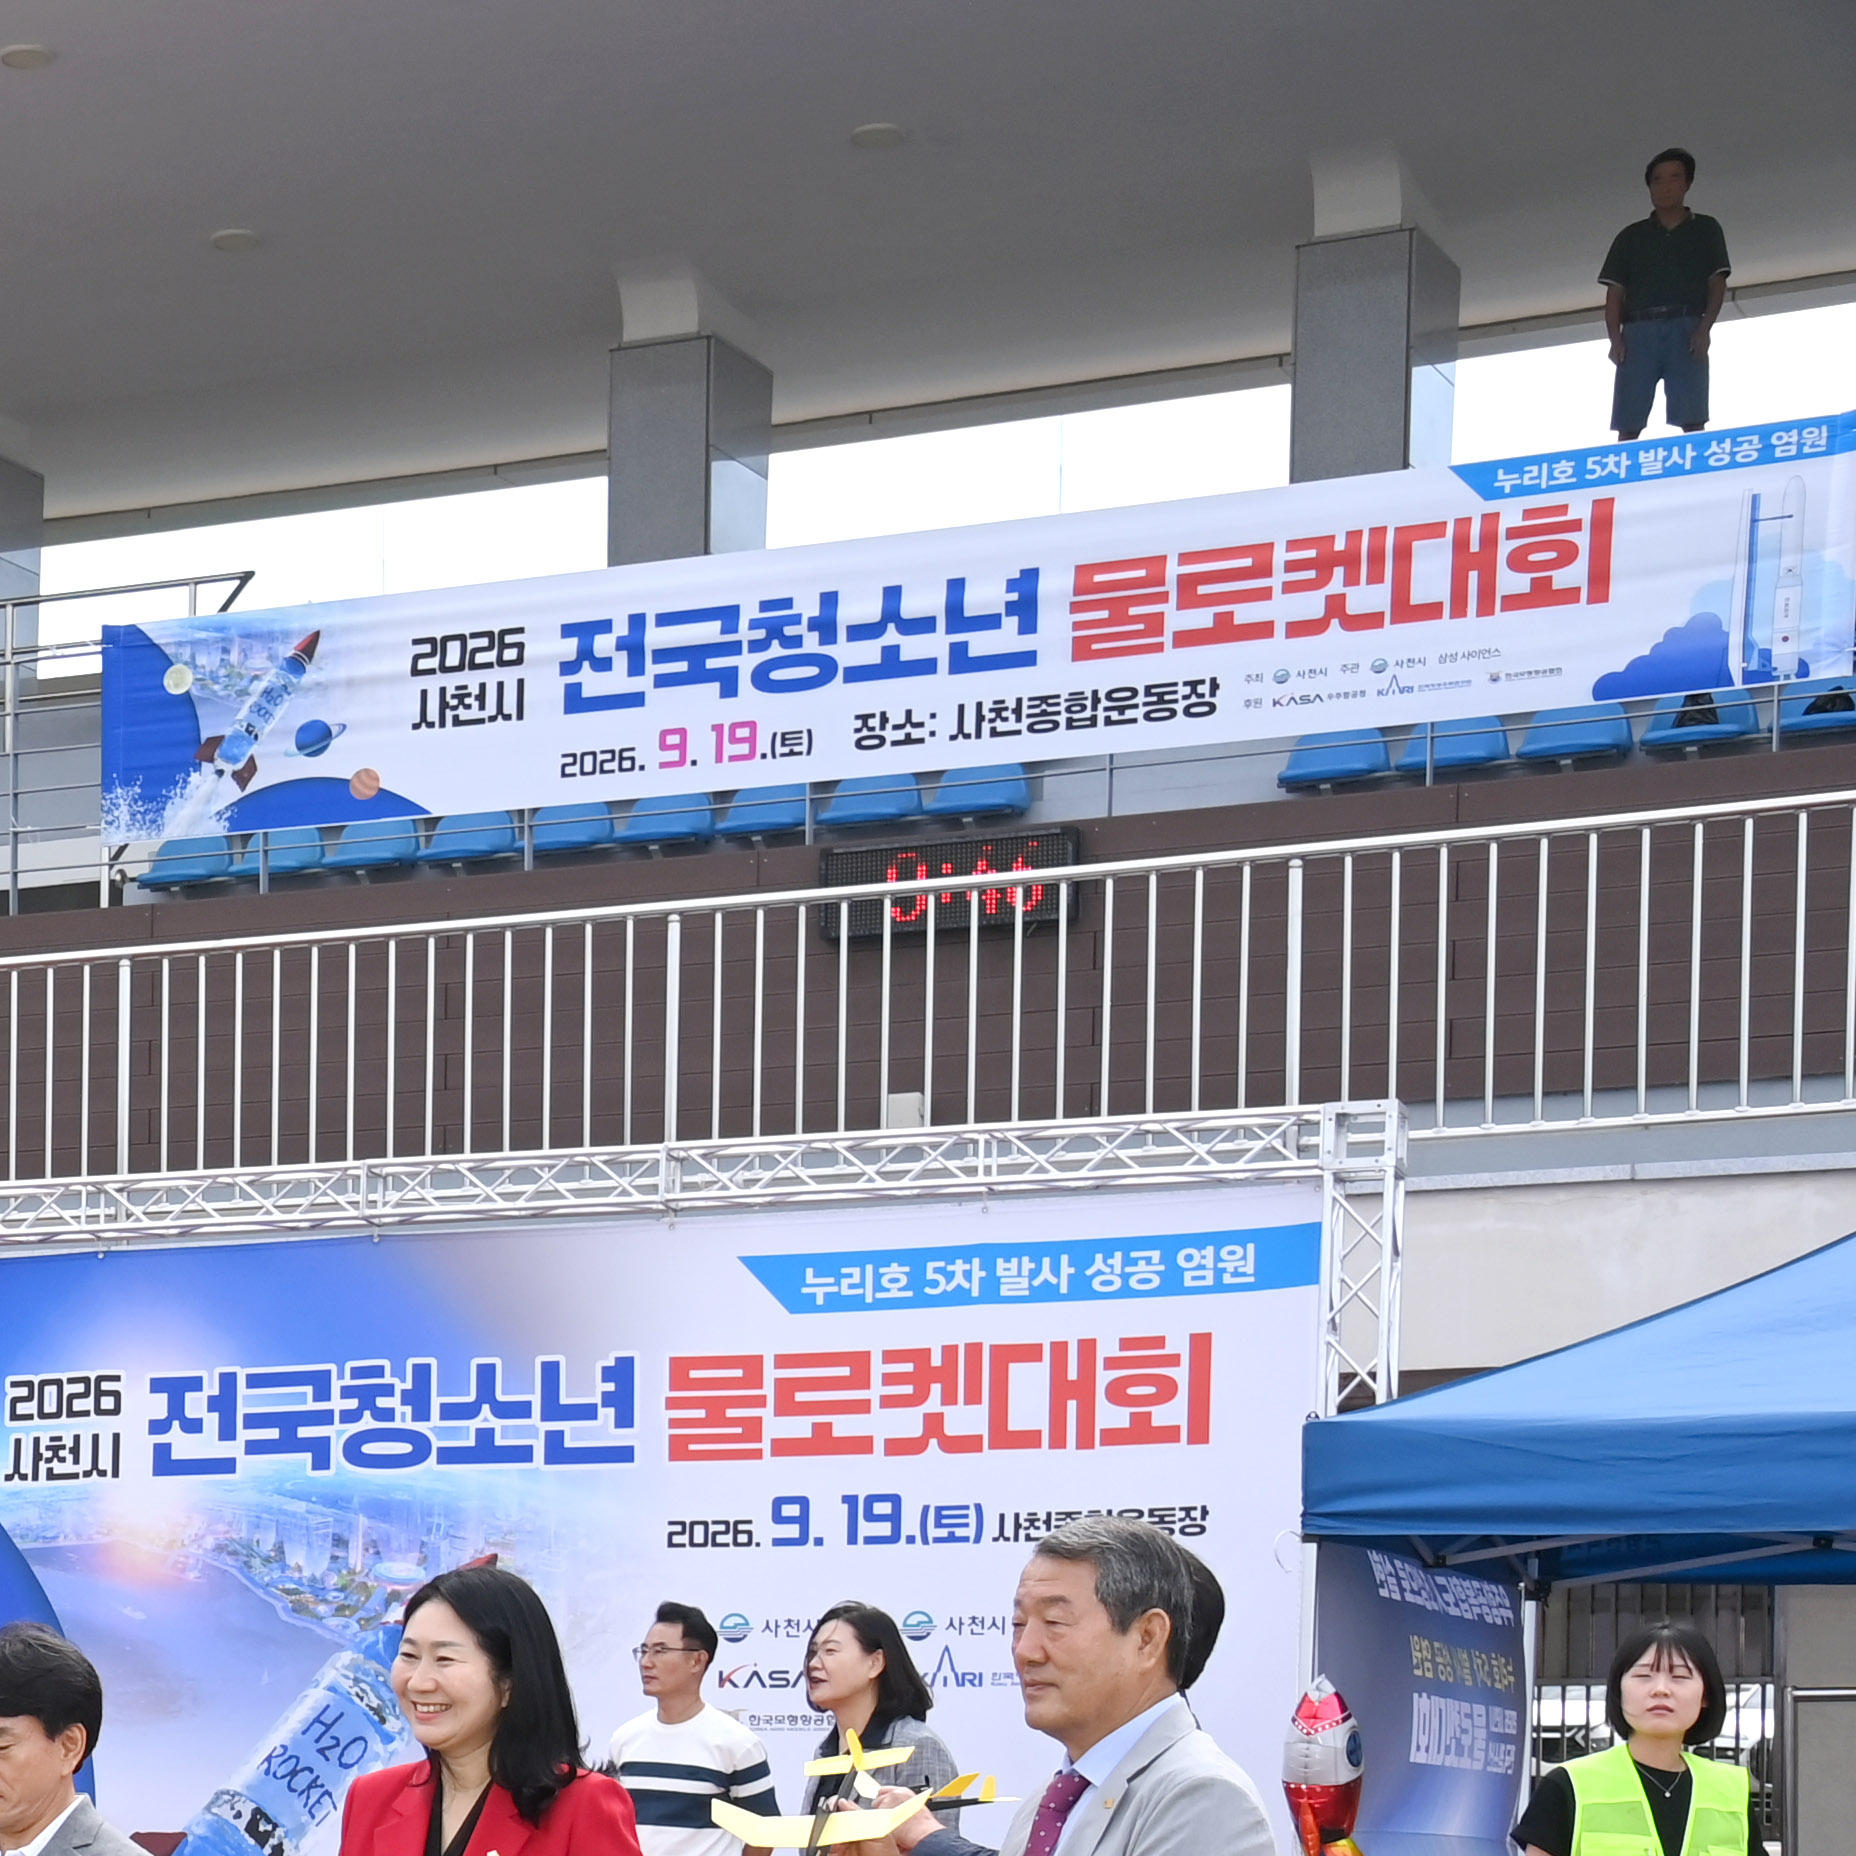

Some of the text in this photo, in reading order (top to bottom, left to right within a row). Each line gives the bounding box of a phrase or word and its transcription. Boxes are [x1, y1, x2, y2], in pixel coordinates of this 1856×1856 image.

[1493, 425, 1828, 493] 누리호 5차 발사 성공 염원
[558, 497, 1616, 715] 전국청소년 물로켓대회
[410, 627, 525, 677] 2026
[1296, 666, 1328, 679] 사천시
[1340, 662, 1360, 675] 주관
[1394, 656, 1426, 669] 사천시
[1460, 646, 1501, 662] 사이언스
[411, 678, 525, 730] 사천시
[1243, 697, 1263, 710] 후원
[1272, 691, 1324, 707] KASA
[560, 746, 646, 778] 2026.
[853, 708, 937, 751] 장소:
[948, 676, 1220, 742] 사천종합운동장
[800, 1242, 1255, 1306] 누리호 5차 발사 성공 염원
[9, 1374, 122, 1423] 2026
[147, 1331, 1212, 1478] 전국청소년 물로켓대회
[4, 1432, 120, 1483] 사천시
[667, 1518, 761, 1548] 2026.
[945, 1615, 1006, 1636] 사천시
